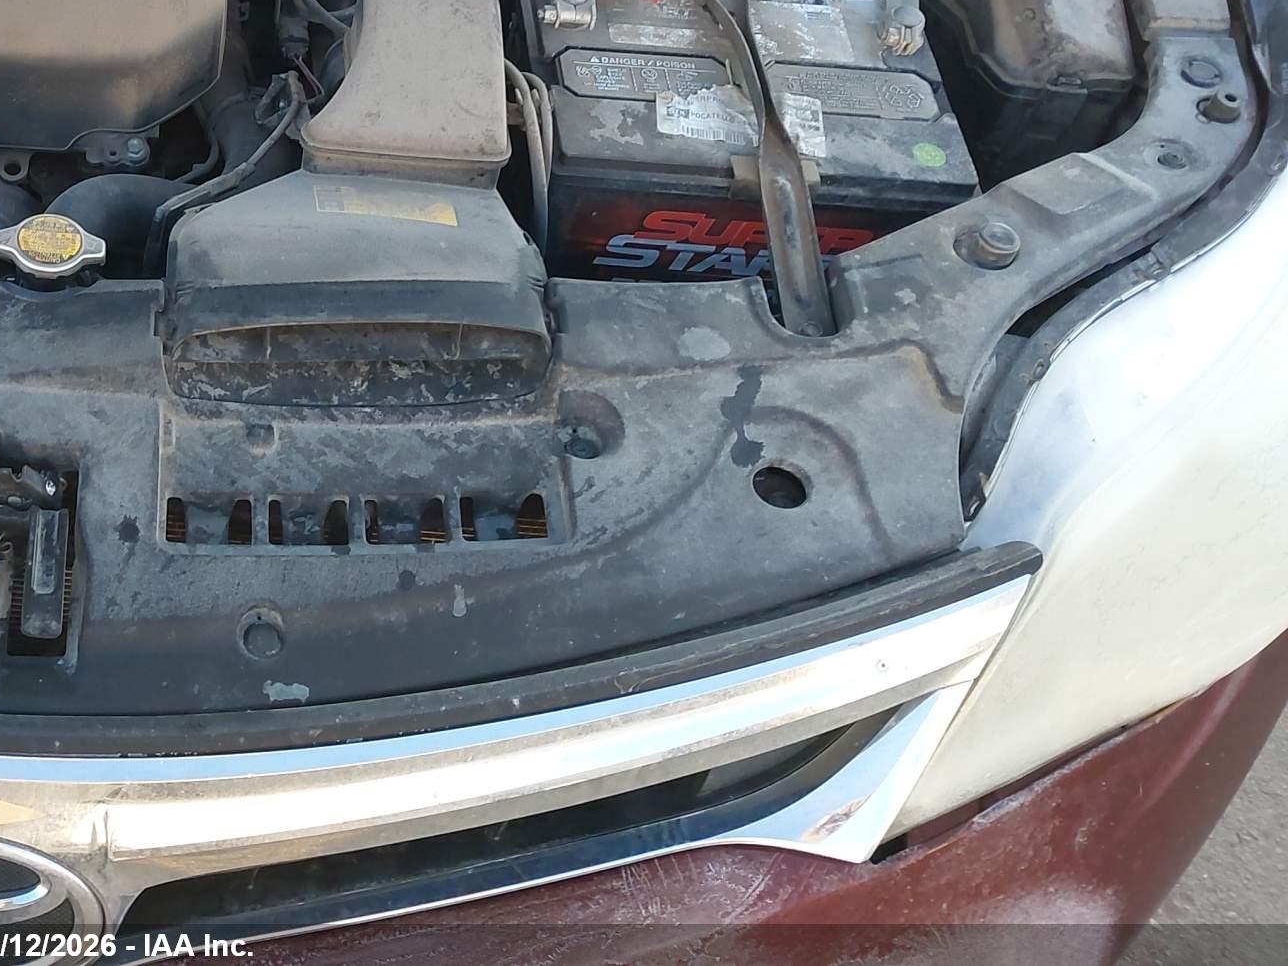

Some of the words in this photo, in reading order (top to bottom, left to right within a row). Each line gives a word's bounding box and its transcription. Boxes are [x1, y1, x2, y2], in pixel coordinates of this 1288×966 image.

[601, 56, 645, 66] DANGER
[656, 61, 695, 70] POISON
[634, 210, 873, 254] SUPR
